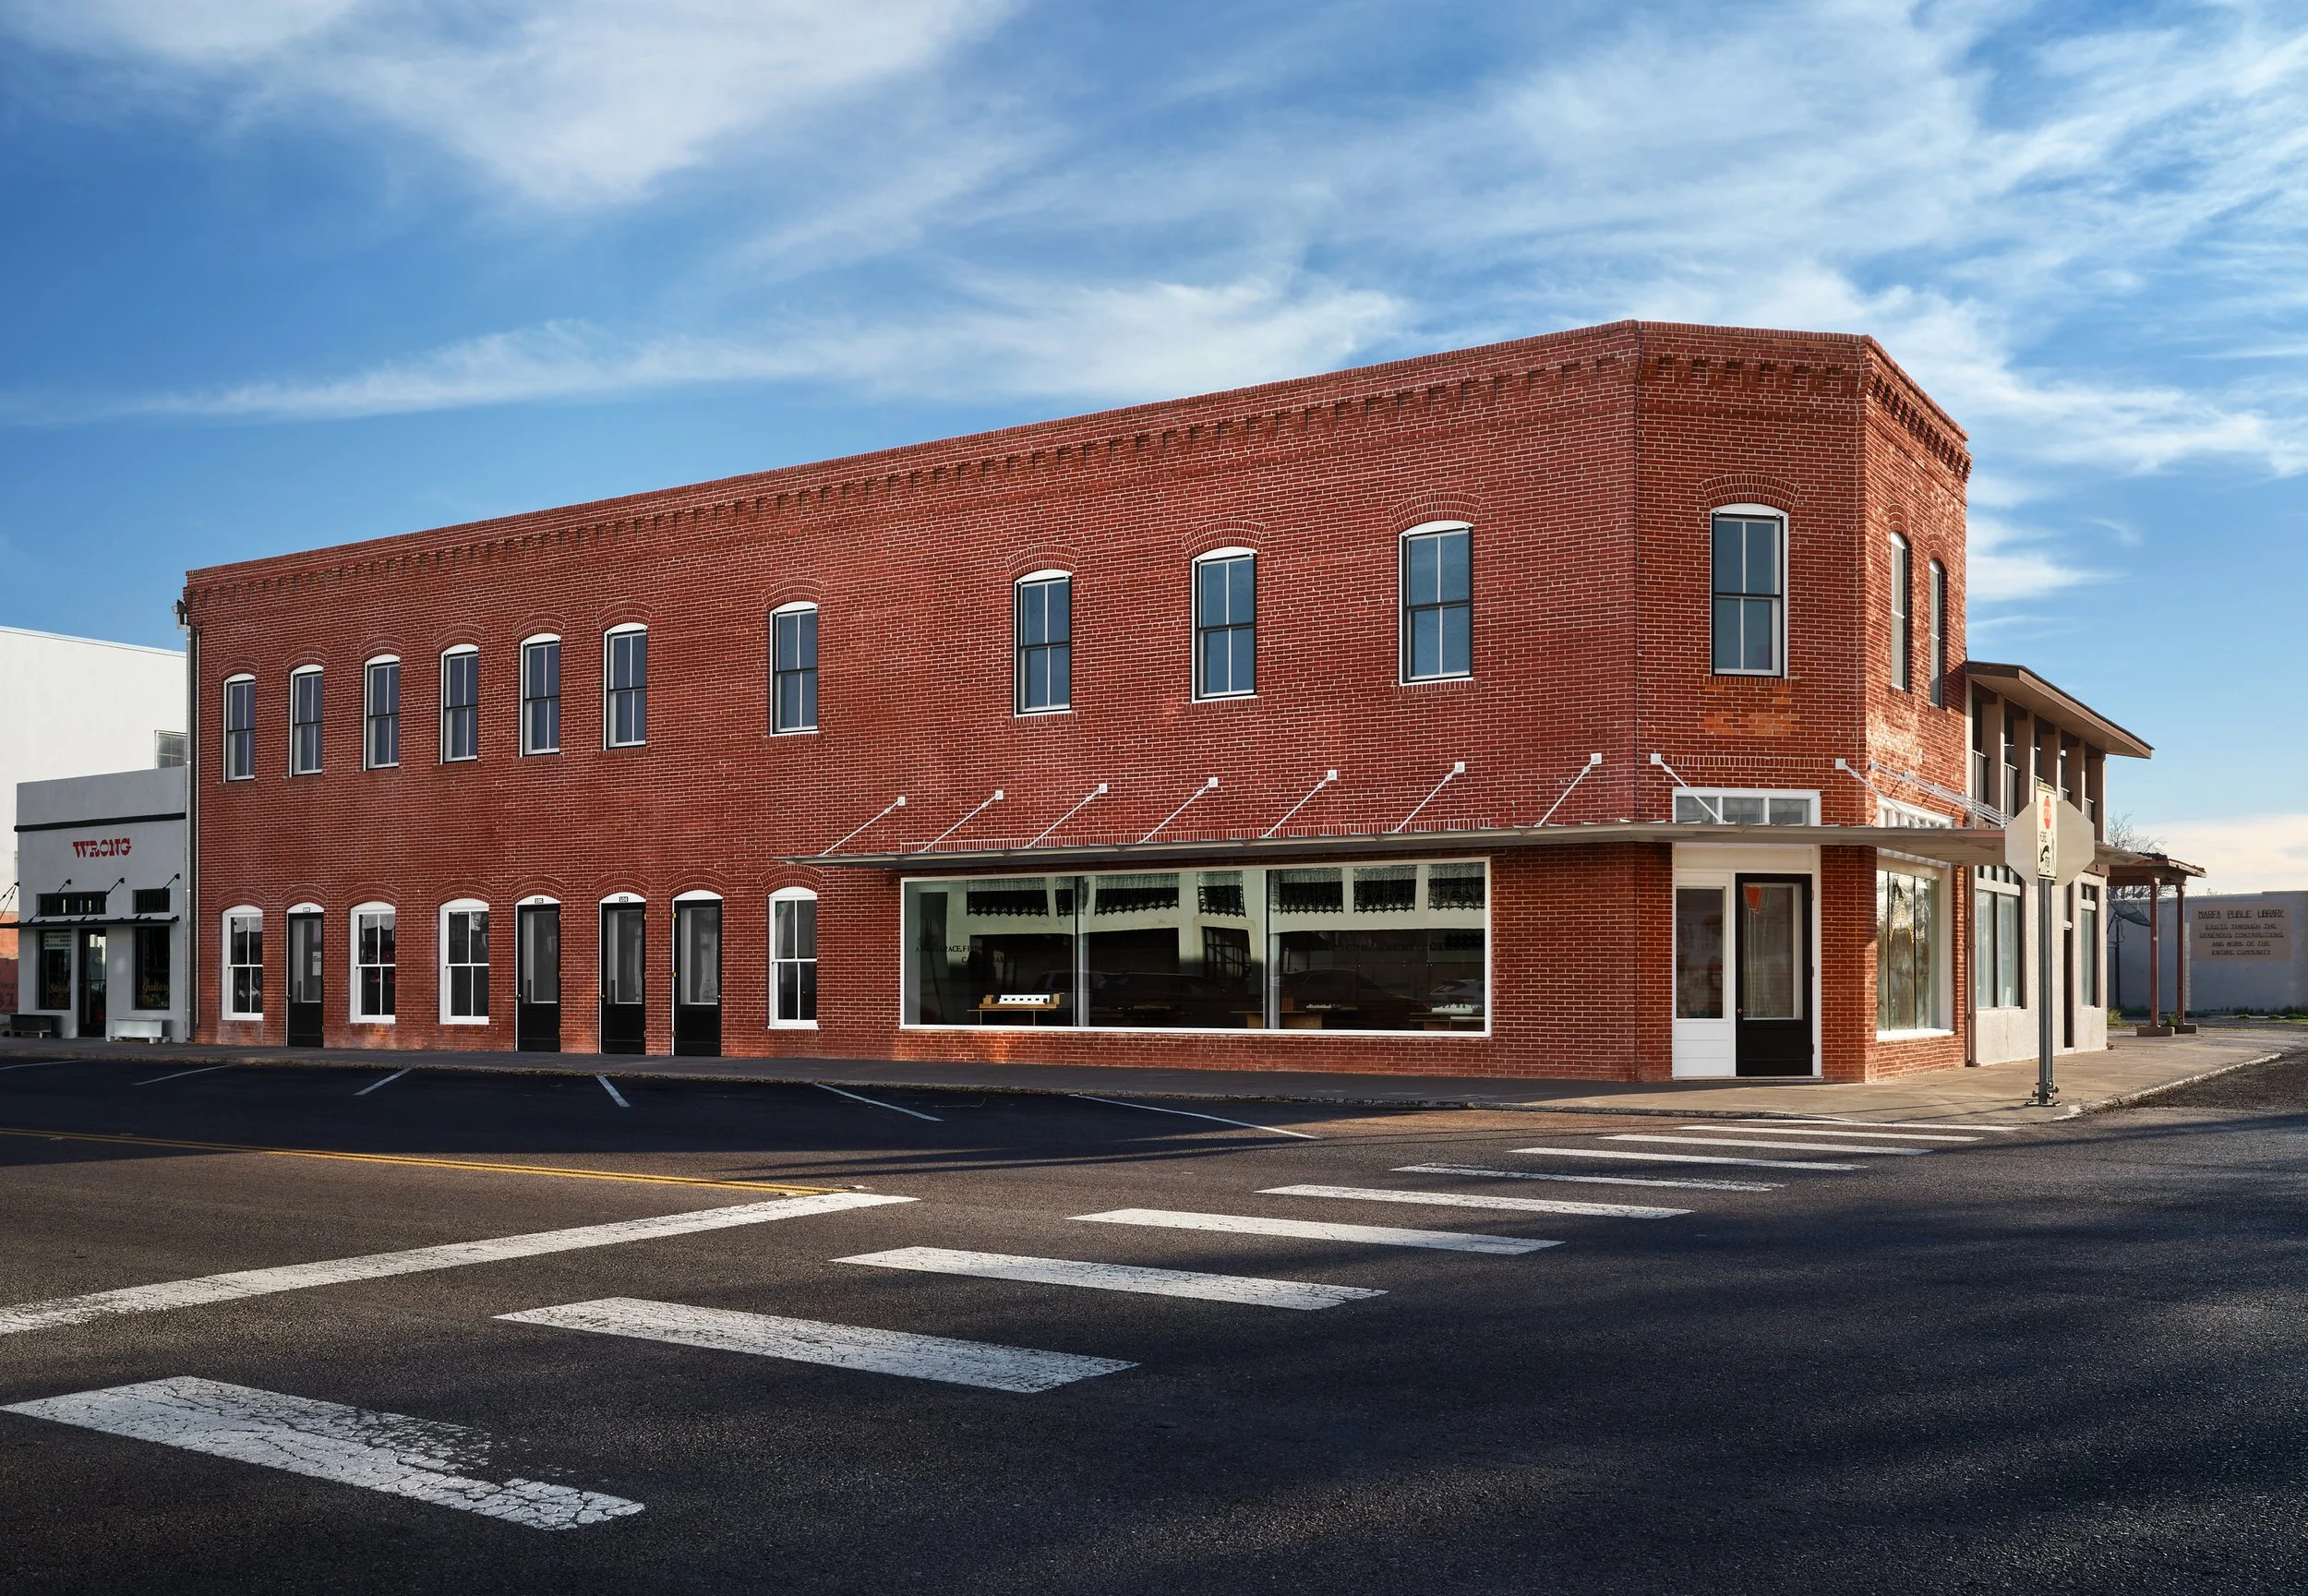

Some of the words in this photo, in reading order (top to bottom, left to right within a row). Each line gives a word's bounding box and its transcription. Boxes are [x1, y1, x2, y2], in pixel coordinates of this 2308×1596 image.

[73, 838, 131, 858] WRONG
[2198, 910, 2220, 918] MARFA
[2228, 910, 2252, 918] PUBLIC
[2257, 909, 2284, 918] LIBRARY
